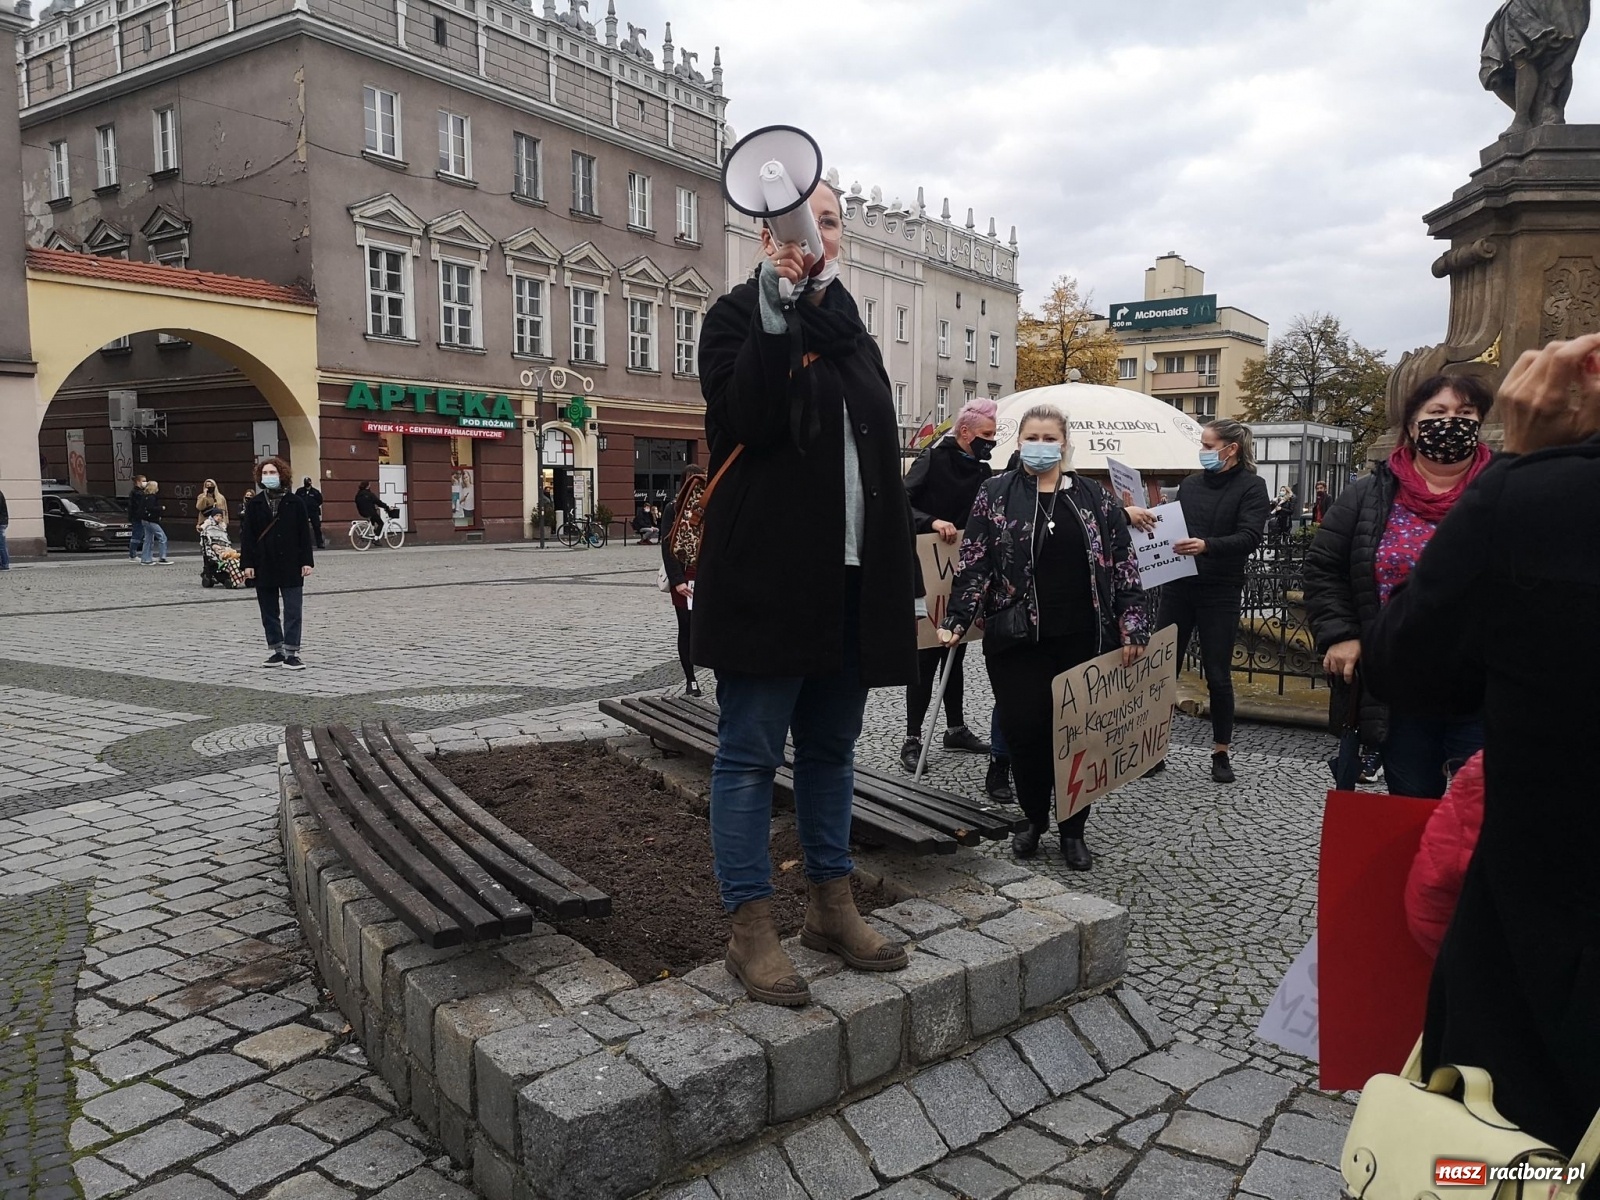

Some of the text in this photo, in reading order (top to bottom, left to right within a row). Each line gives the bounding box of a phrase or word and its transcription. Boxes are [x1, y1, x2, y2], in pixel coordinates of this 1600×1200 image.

[1135, 307, 1189, 320] McDonald's
[345, 381, 515, 419] APTEKA
[482, 419, 514, 428] RÓŻAMI
[1097, 419, 1166, 434] RACIBÓRZ
[367, 424, 394, 432] RYNEK
[409, 426, 443, 434] CENTRUM
[444, 428, 502, 438] FARMACEUTYCZNE
[1088, 438, 1121, 452] 1567
[1139, 540, 1169, 553] CZUJĘ
[1060, 678, 1077, 719] A
[1085, 703, 1174, 793] JA TEŻ NIE!
